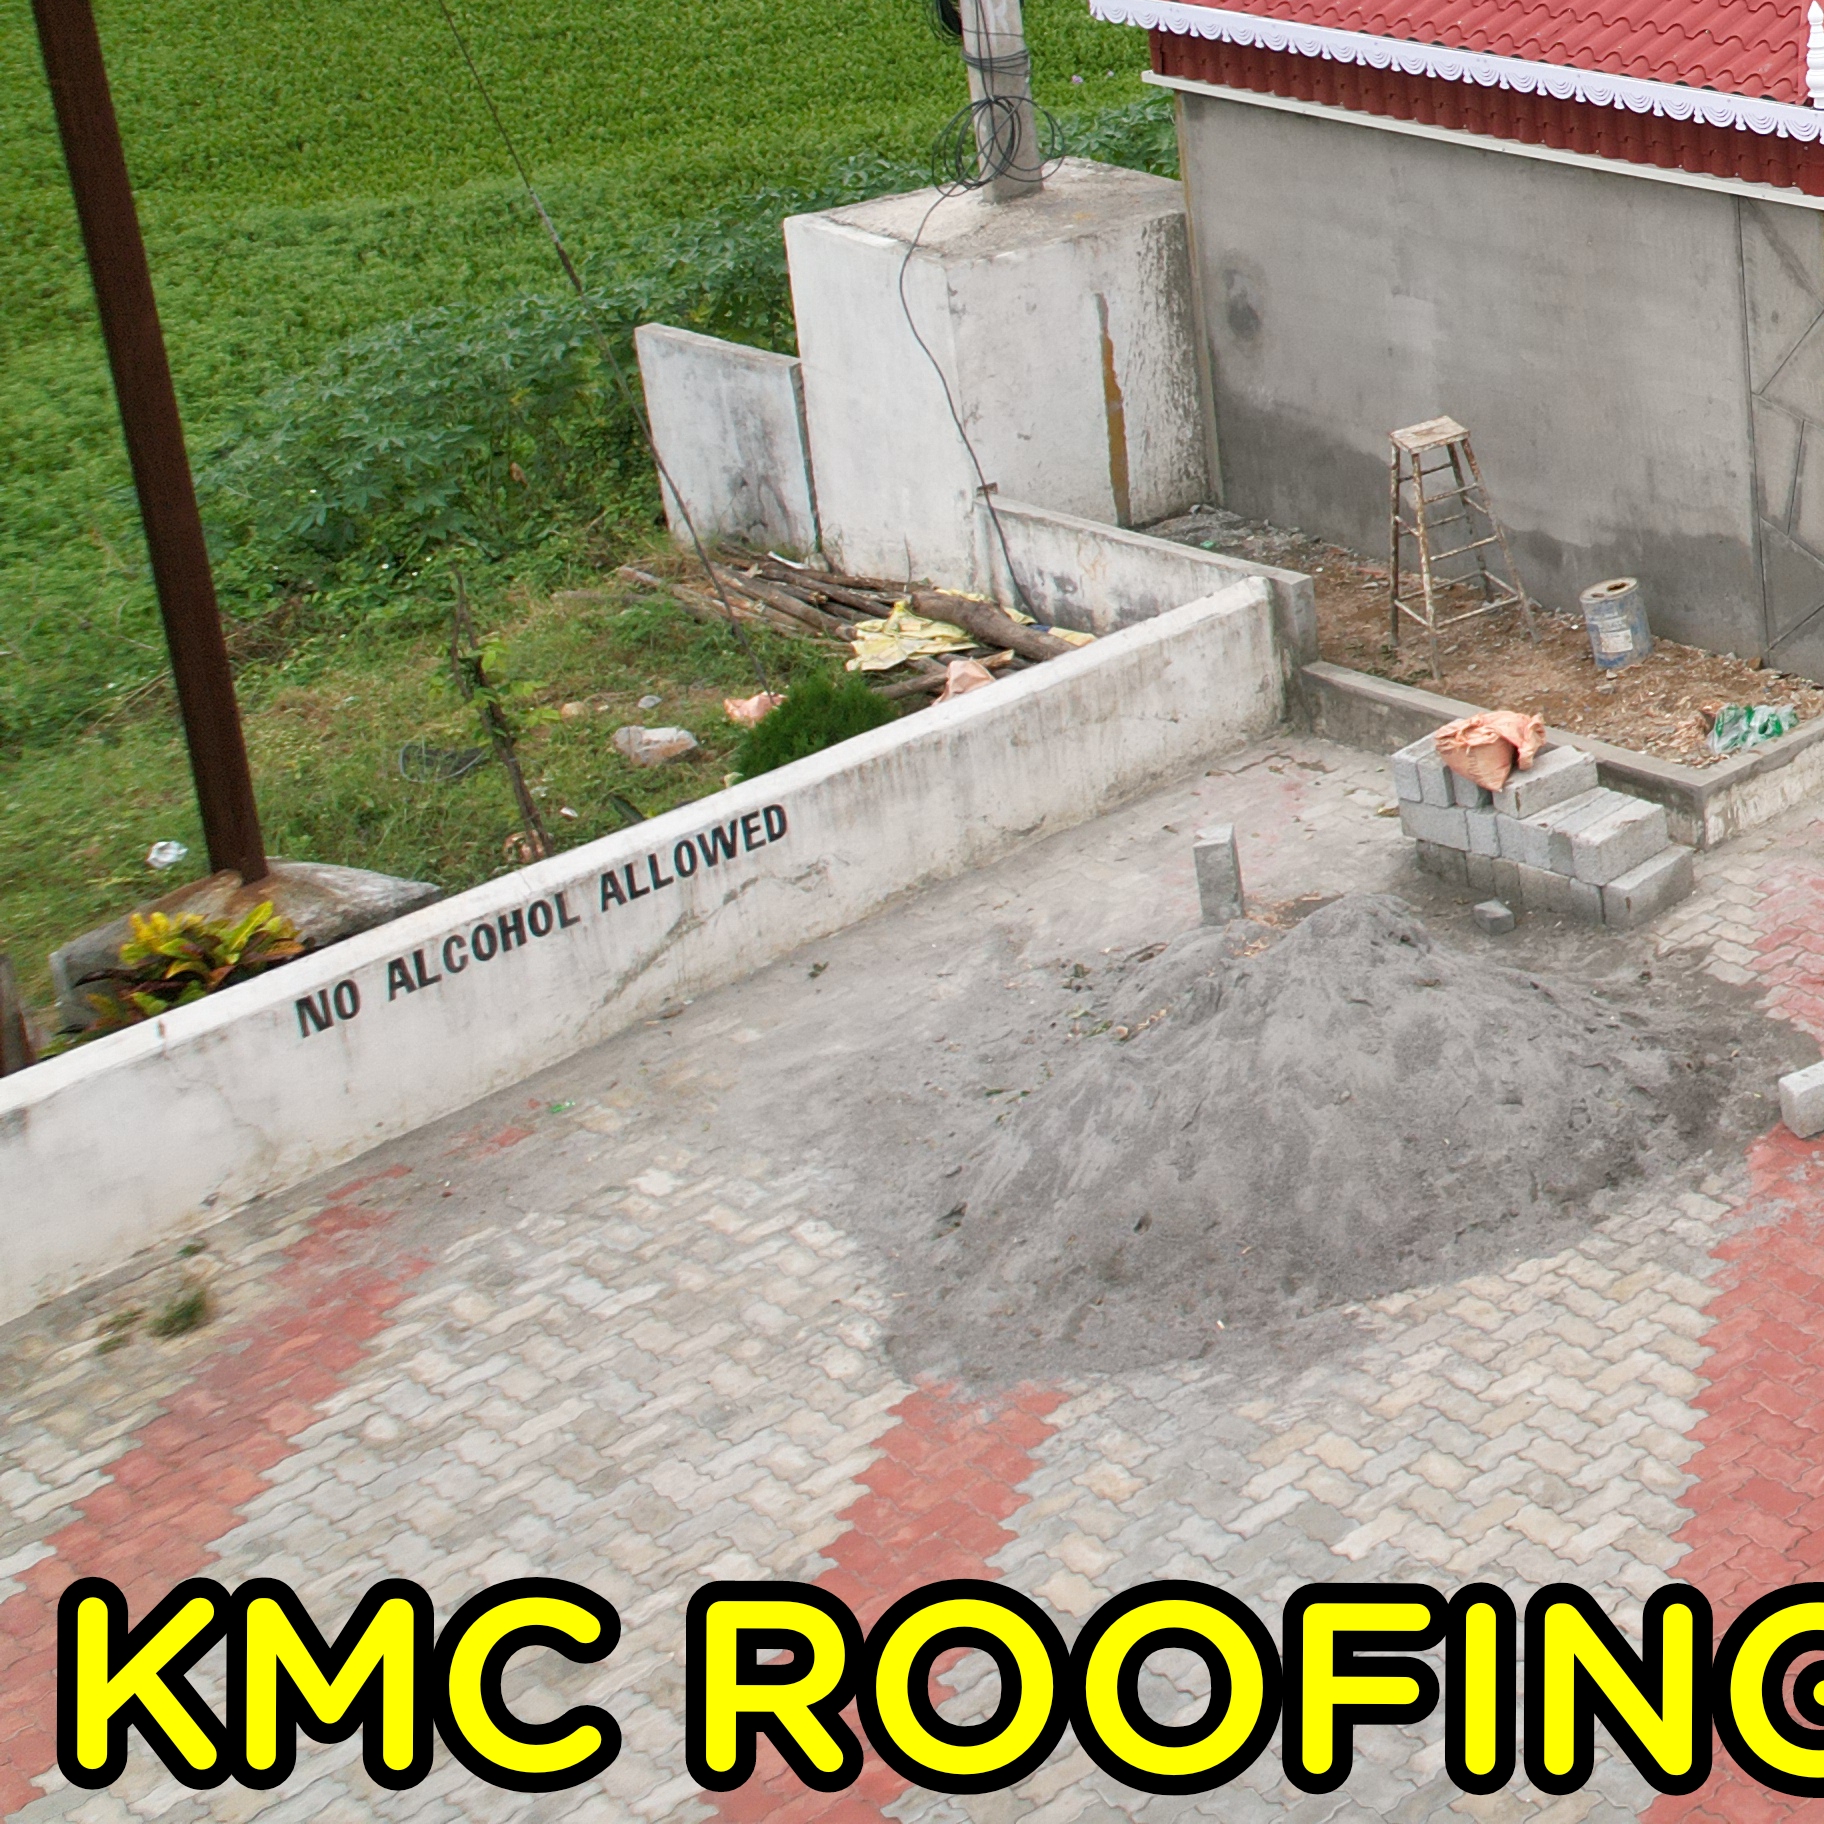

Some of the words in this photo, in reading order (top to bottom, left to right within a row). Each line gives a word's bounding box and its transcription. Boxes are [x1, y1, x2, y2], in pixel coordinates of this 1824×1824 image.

[295, 979, 361, 1038] NO
[387, 892, 581, 1002] ALCOHOL
[600, 803, 788, 912] ALLOWED
